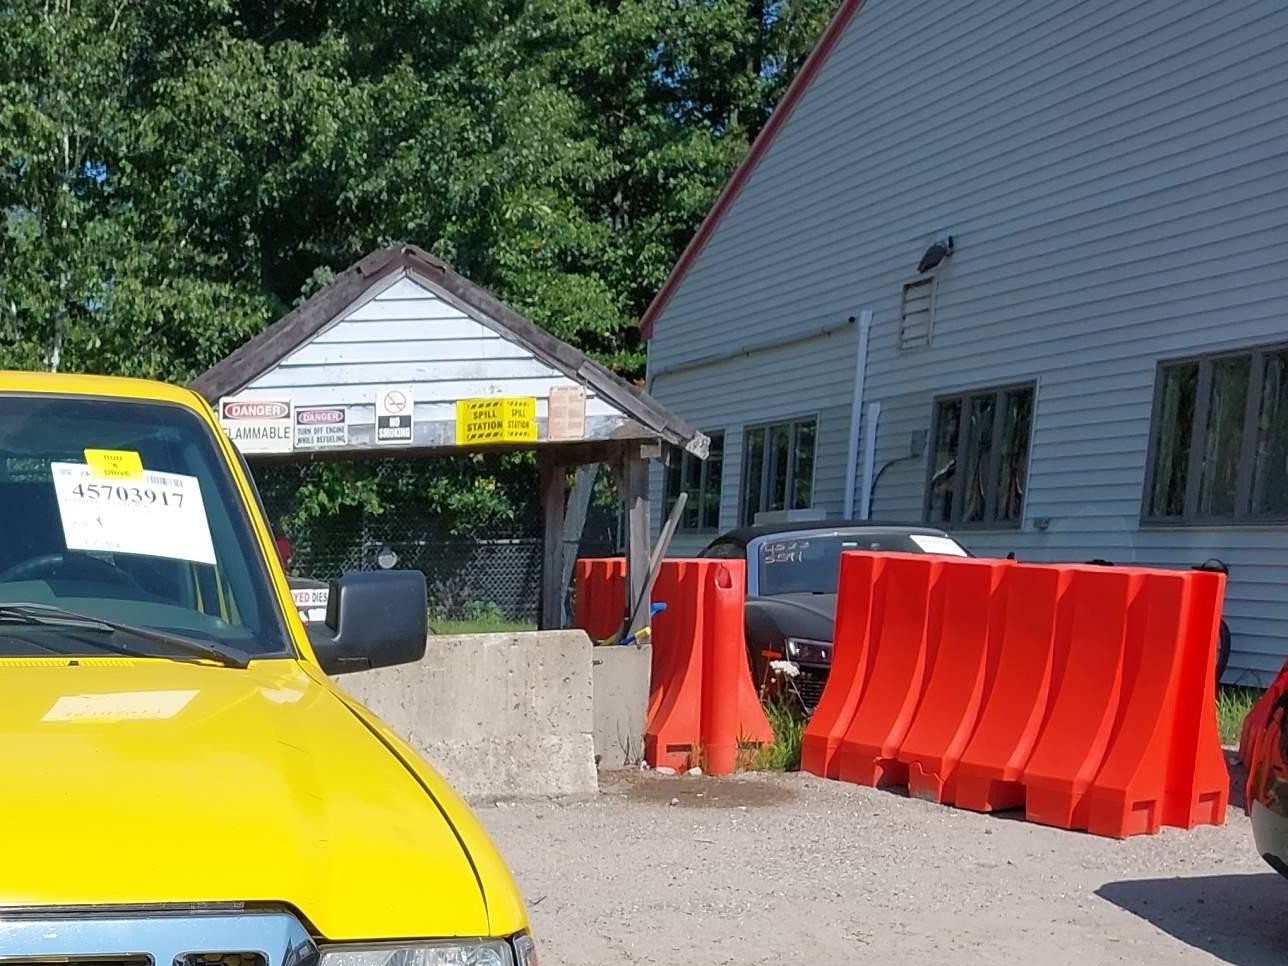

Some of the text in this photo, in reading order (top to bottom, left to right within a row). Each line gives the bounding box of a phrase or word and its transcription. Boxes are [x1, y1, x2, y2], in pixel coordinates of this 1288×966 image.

[232, 406, 281, 416] DANGER
[472, 410, 497, 420] SPILL
[512, 409, 525, 417] SPILL
[302, 411, 340, 422] DANGER
[389, 416, 401, 427] NO
[467, 421, 503, 432] STATION
[508, 420, 529, 429] STATION
[378, 427, 411, 438] SMOKING
[72, 483, 184, 508] 45703917
[294, 592, 328, 602] YED DIES
